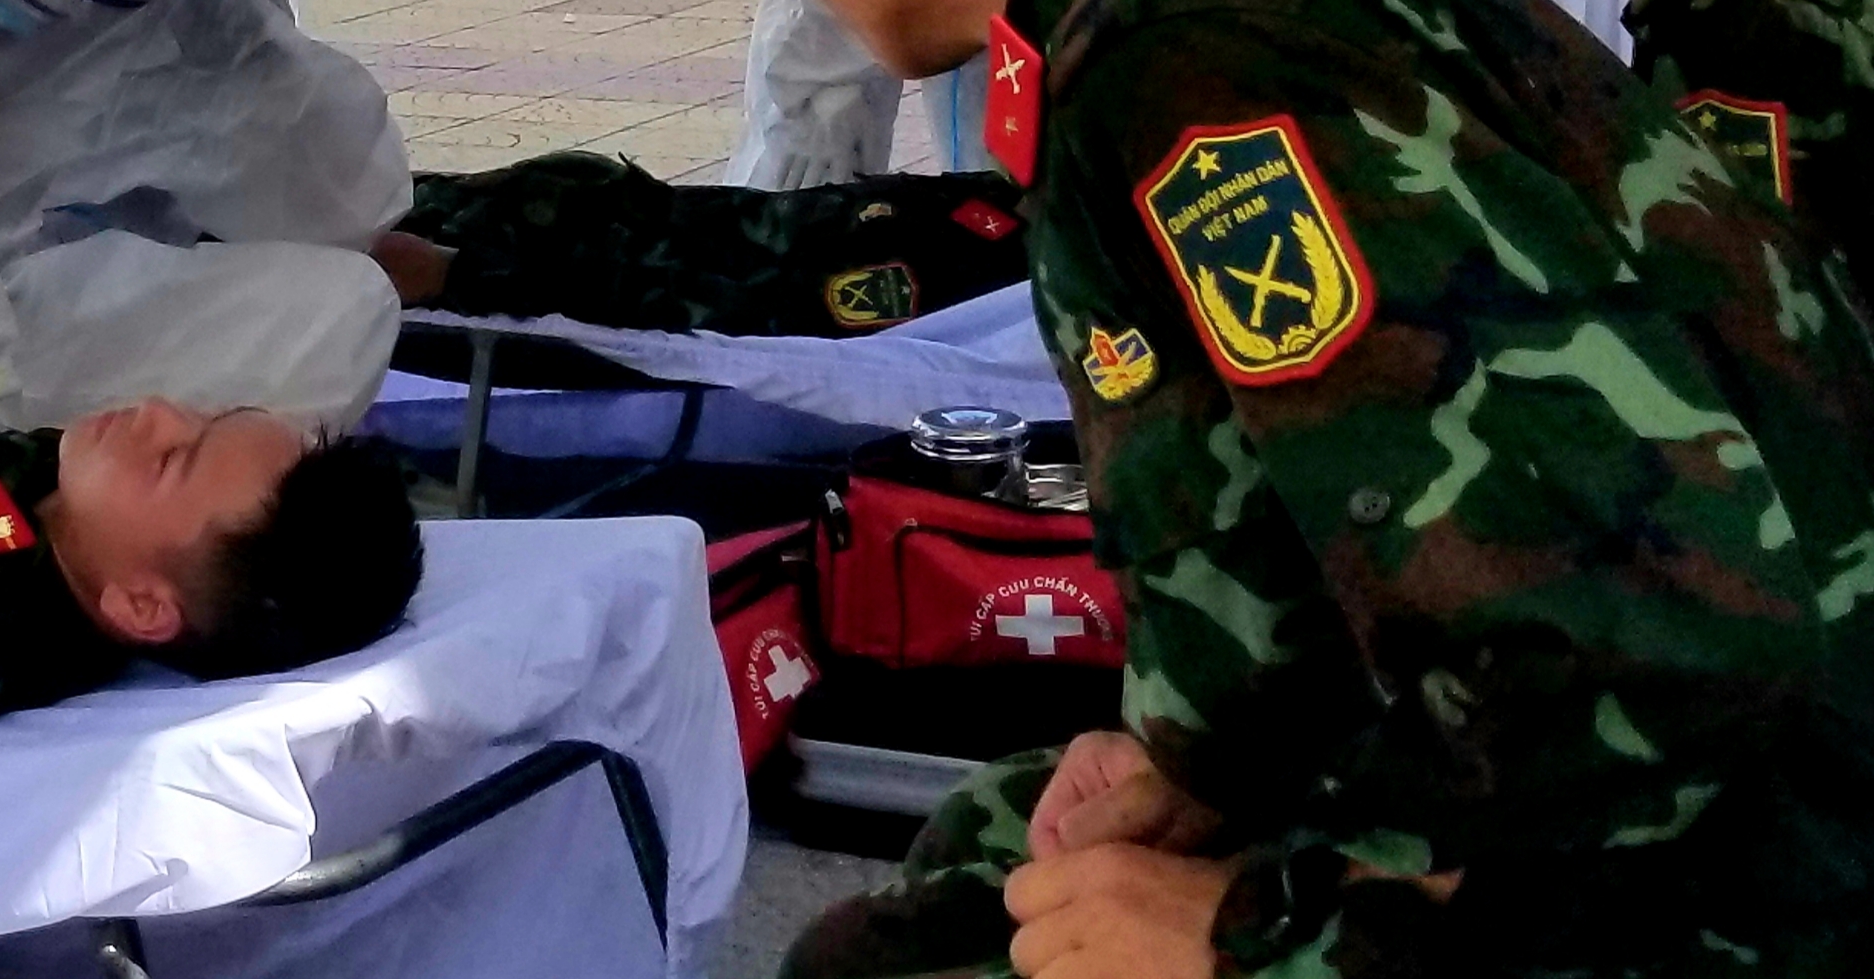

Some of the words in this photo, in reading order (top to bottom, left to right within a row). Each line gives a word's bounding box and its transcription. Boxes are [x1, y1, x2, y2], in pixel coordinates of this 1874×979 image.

[1168, 203, 1202, 235] QUÂN
[1218, 171, 1260, 201] NHÂN
[1255, 158, 1291, 183] DÂN
[1202, 213, 1234, 242] VIỆT
[1232, 193, 1268, 224] NAM
